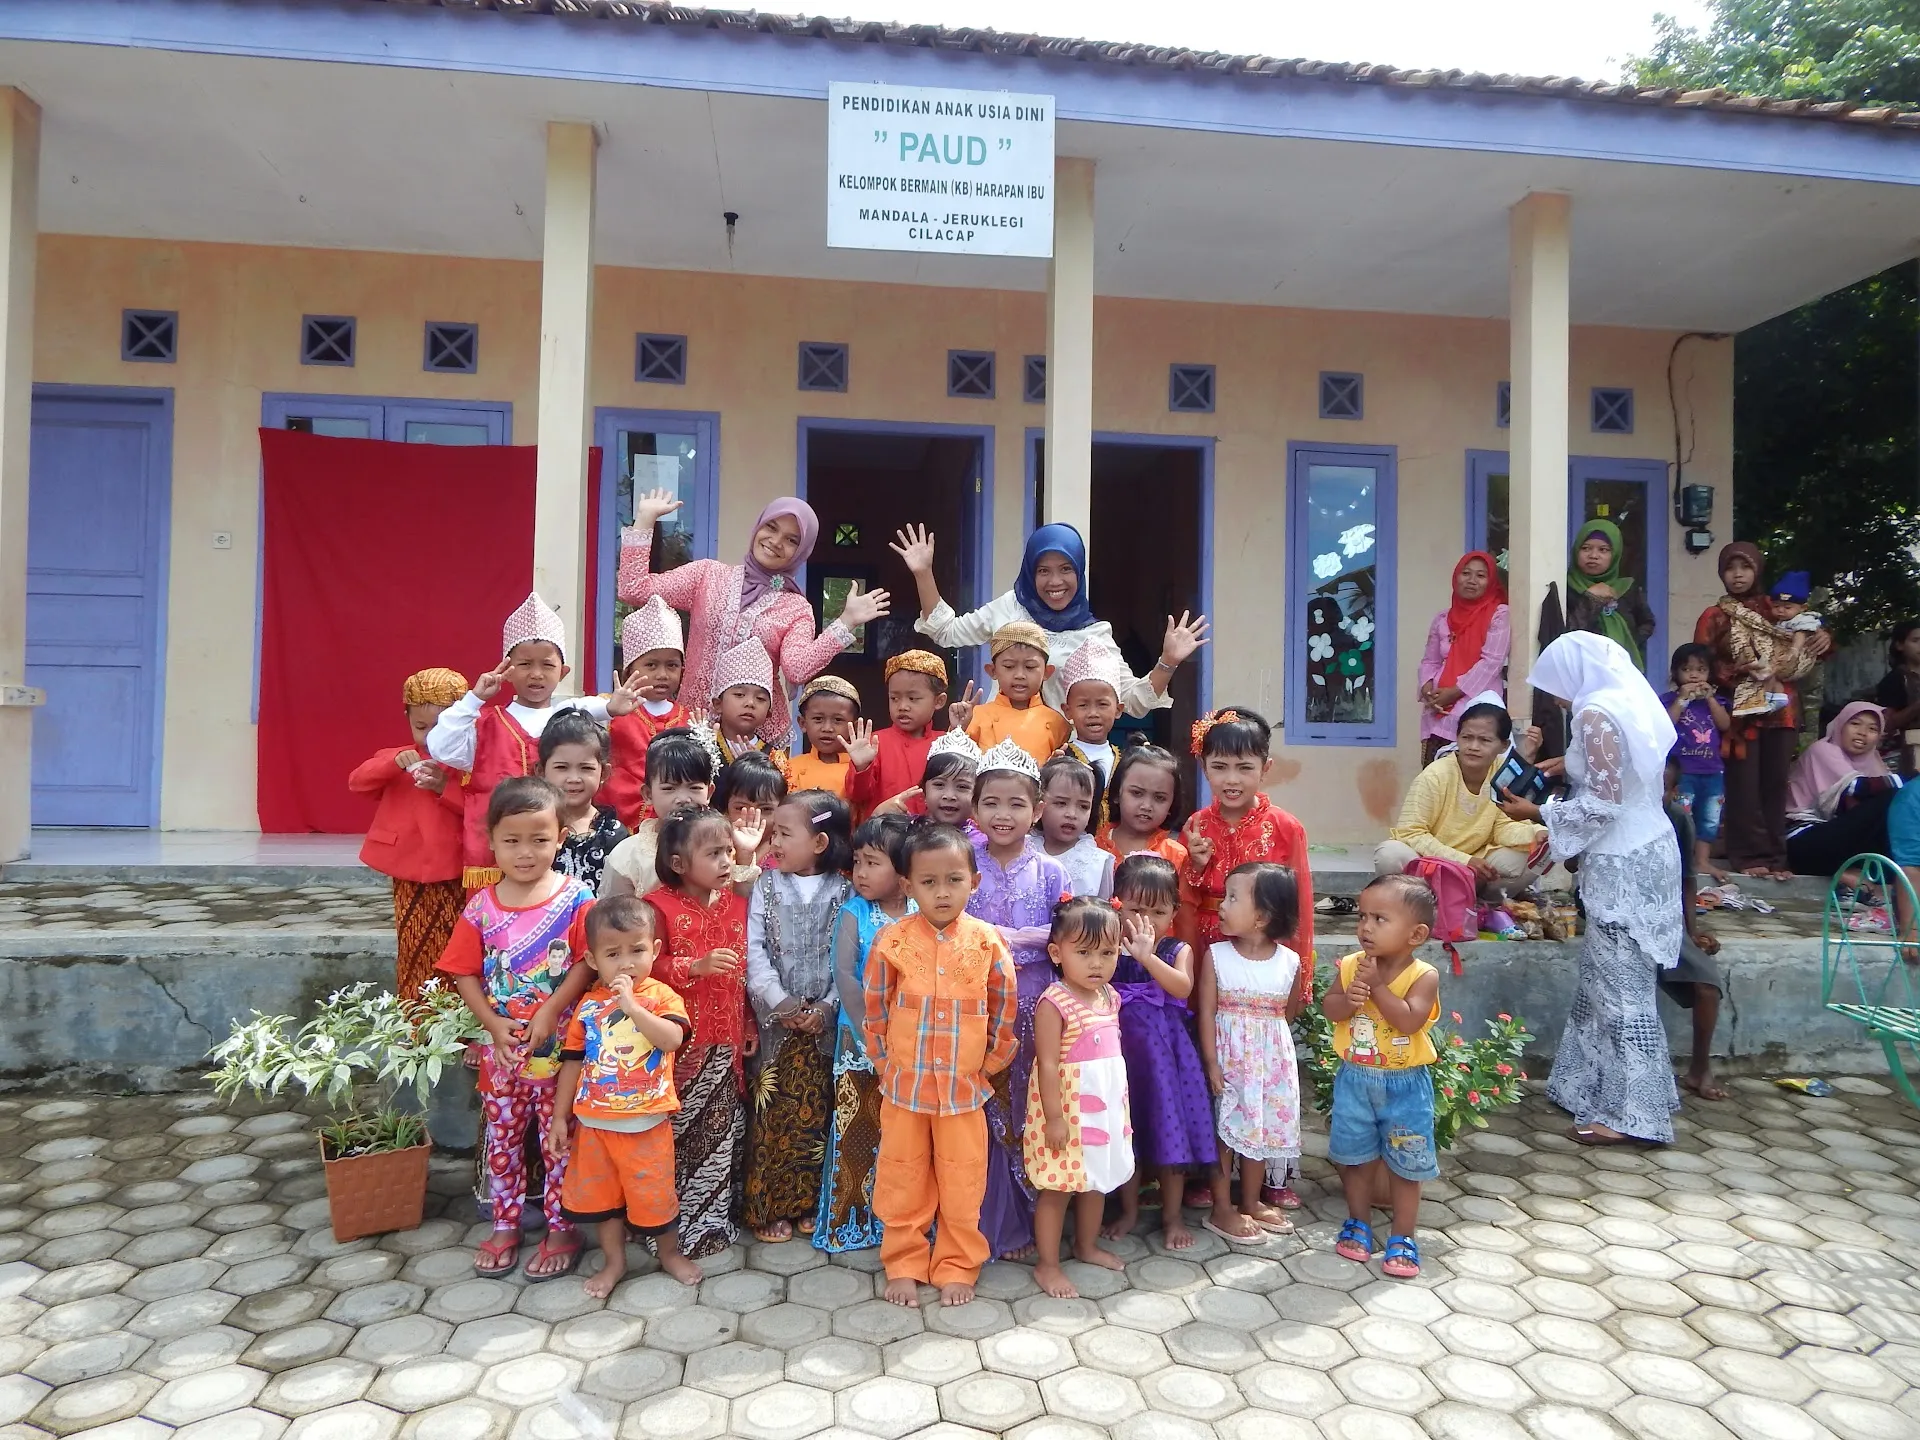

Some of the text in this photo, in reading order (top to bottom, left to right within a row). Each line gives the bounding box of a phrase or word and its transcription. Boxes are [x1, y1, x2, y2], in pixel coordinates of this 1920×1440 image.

[843, 95, 1045, 122] PENDIDIKAN ANAK USIA DINI
[900, 131, 987, 166] PAUD
[839, 174, 1045, 200] KELOMPOK BERMAIN (KB) HARAPAN IBU
[859, 208, 929, 223] MANDALA
[942, 213, 1024, 228] JERUKLEGI
[908, 227, 975, 242] CILACAP
